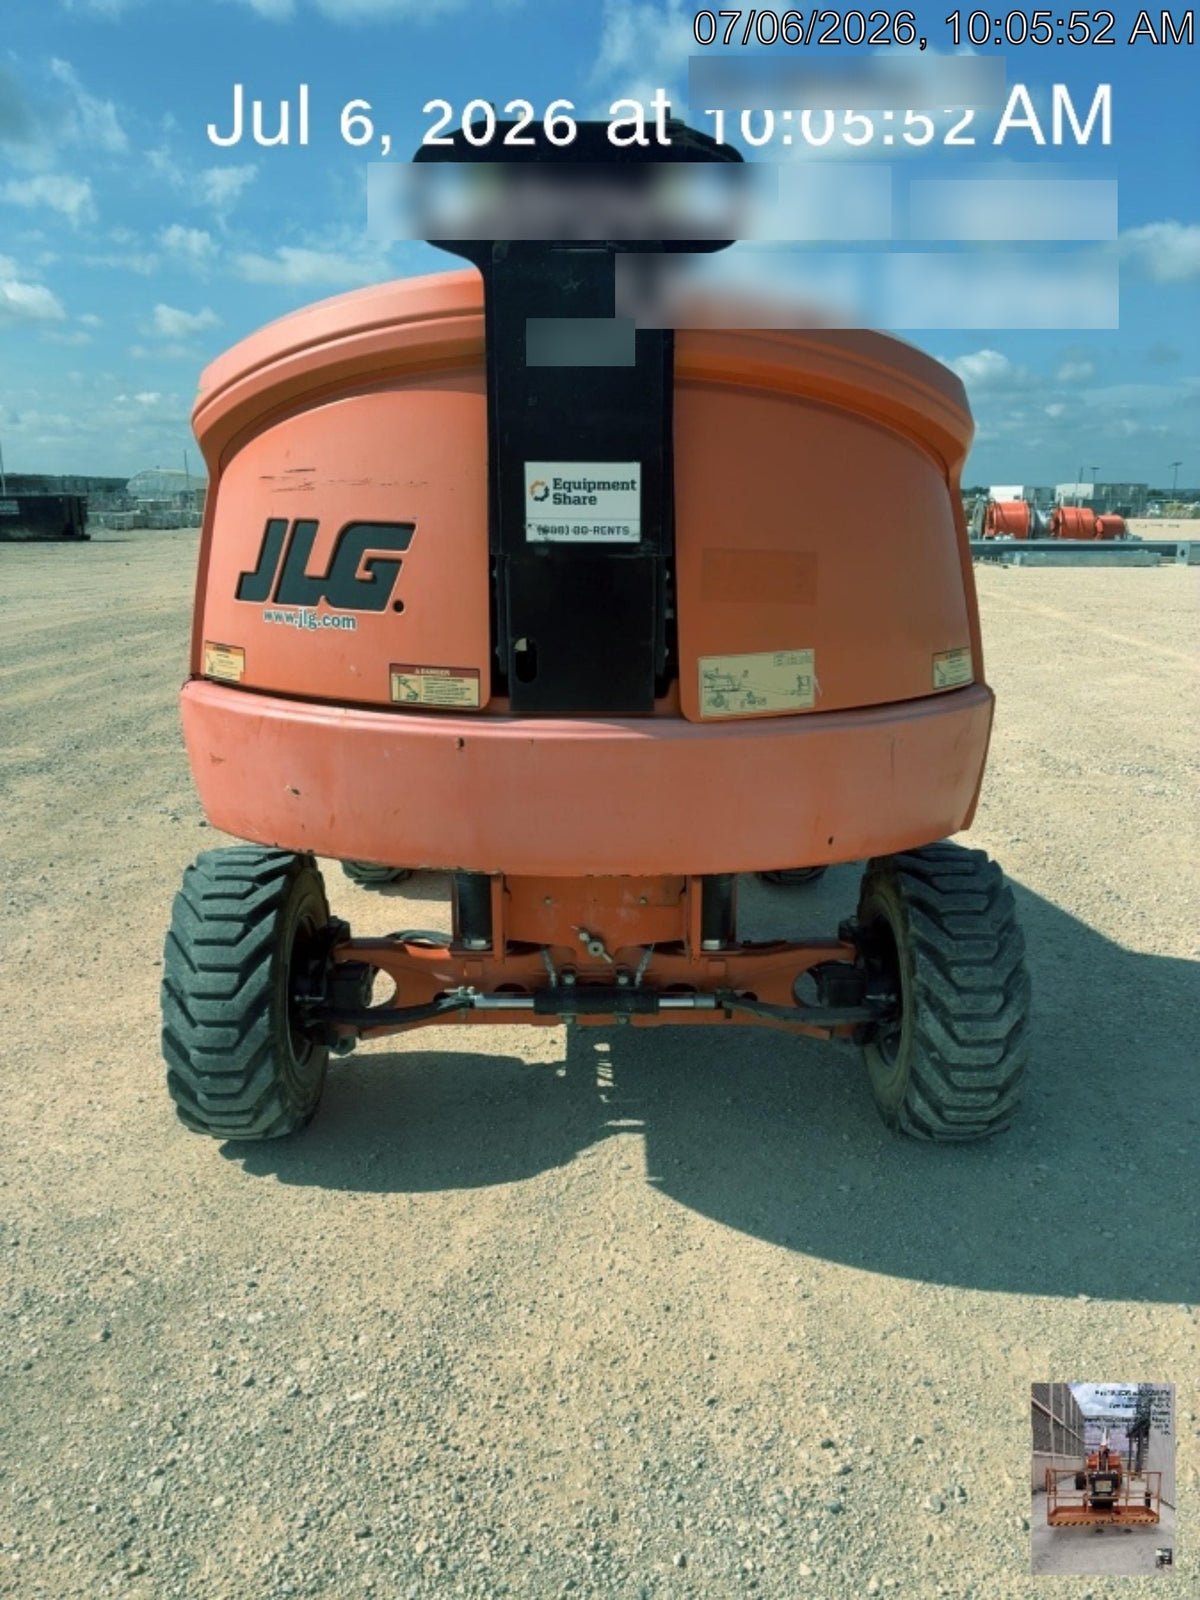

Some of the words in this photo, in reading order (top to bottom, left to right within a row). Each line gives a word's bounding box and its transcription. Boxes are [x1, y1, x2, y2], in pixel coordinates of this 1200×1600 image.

[552, 477, 637, 493] Equipment
[552, 492, 597, 506] Share
[263, 609, 356, 630] www.jlg.com
